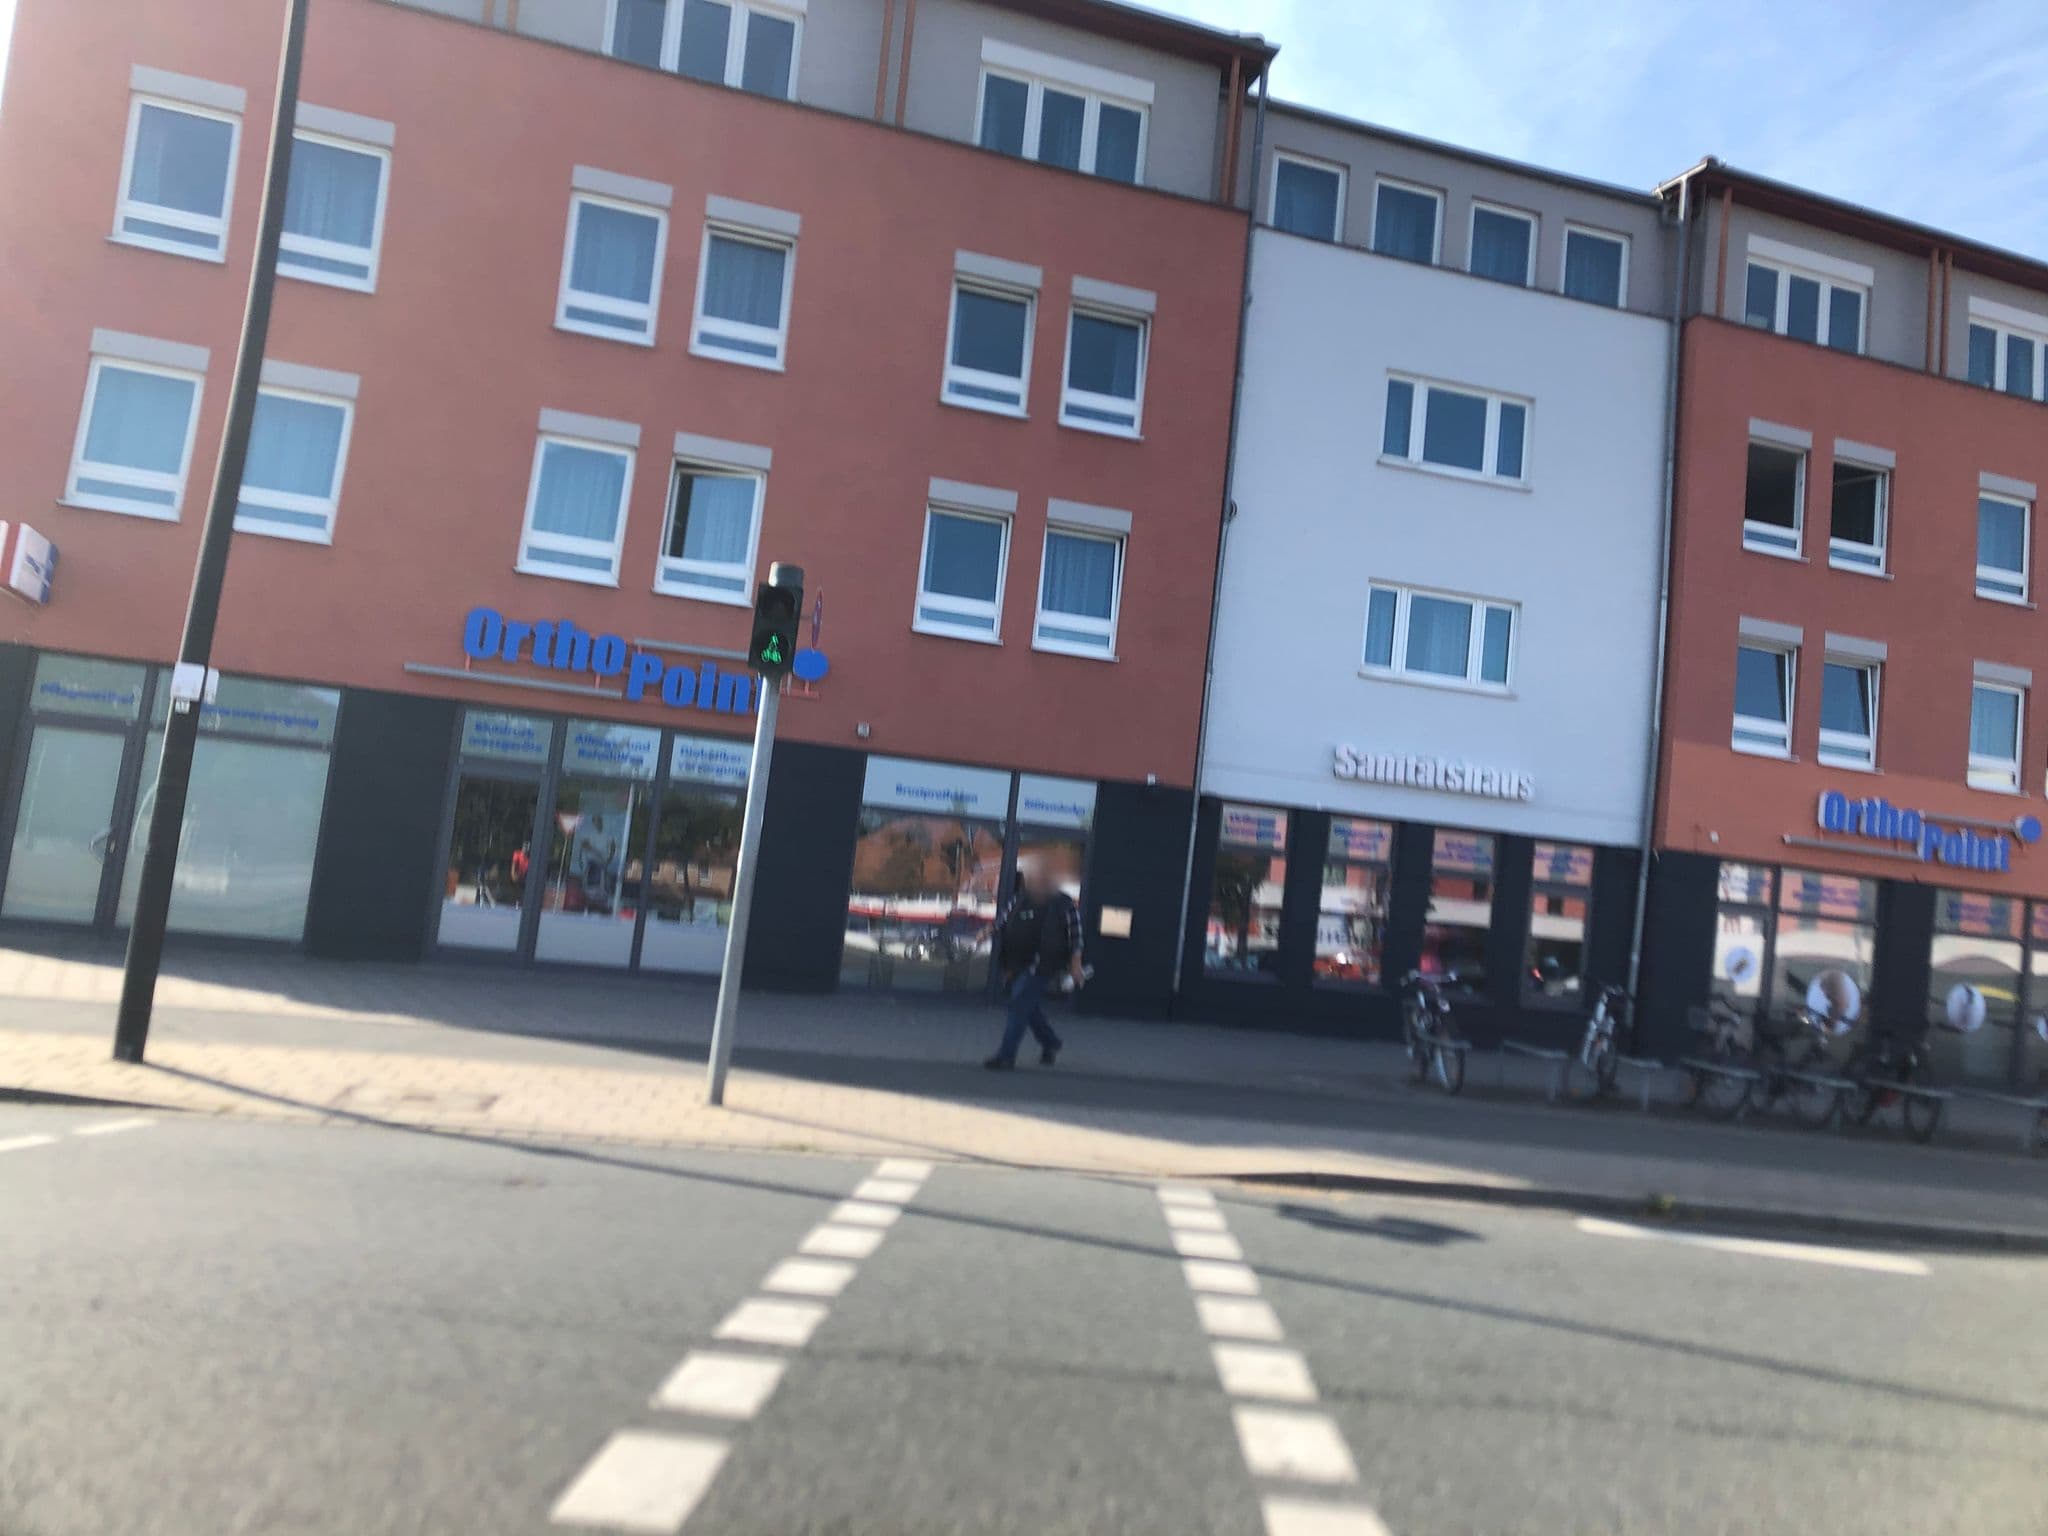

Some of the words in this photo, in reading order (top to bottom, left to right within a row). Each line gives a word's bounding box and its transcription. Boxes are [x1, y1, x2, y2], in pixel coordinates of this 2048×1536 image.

[464, 608, 627, 675] Ortho
[1818, 791, 1921, 842] Ortho
[1918, 823, 2010, 872] Point
